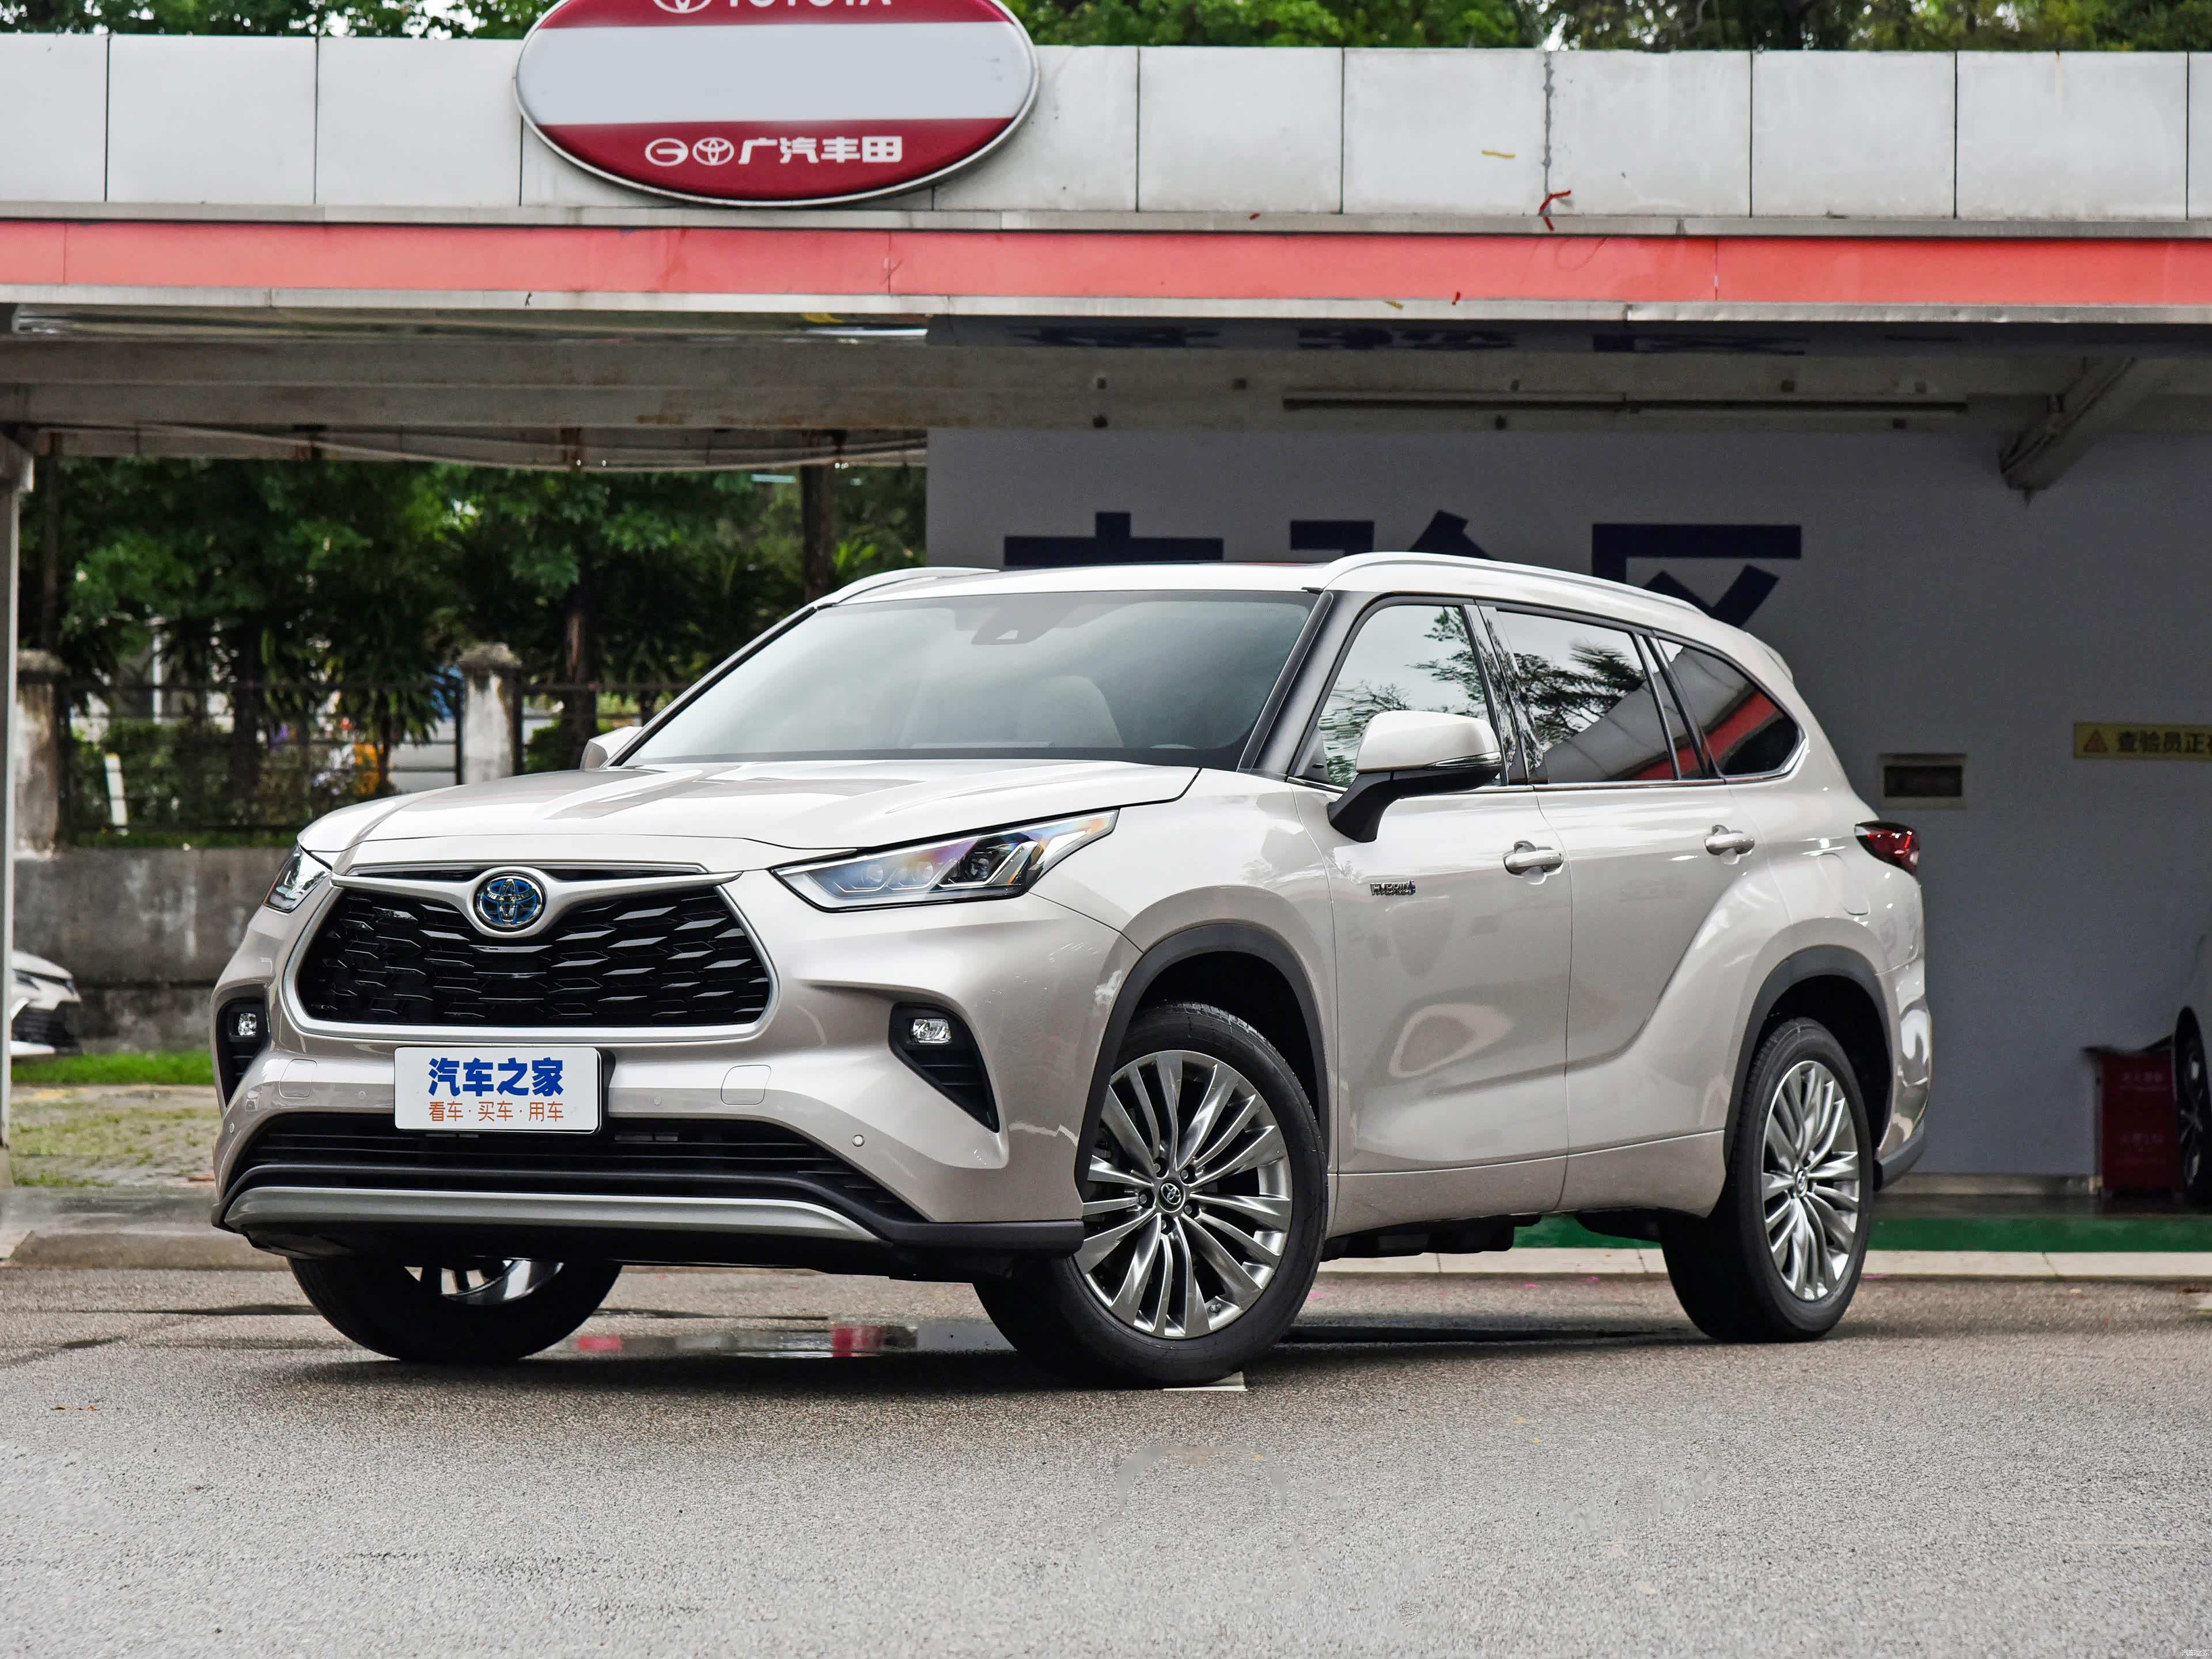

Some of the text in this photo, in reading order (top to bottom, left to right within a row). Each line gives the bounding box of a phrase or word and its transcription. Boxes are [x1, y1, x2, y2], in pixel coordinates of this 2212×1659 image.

[738, 136, 903, 164] 广汽丰田
[428, 1056, 564, 1097] 汽车之家
